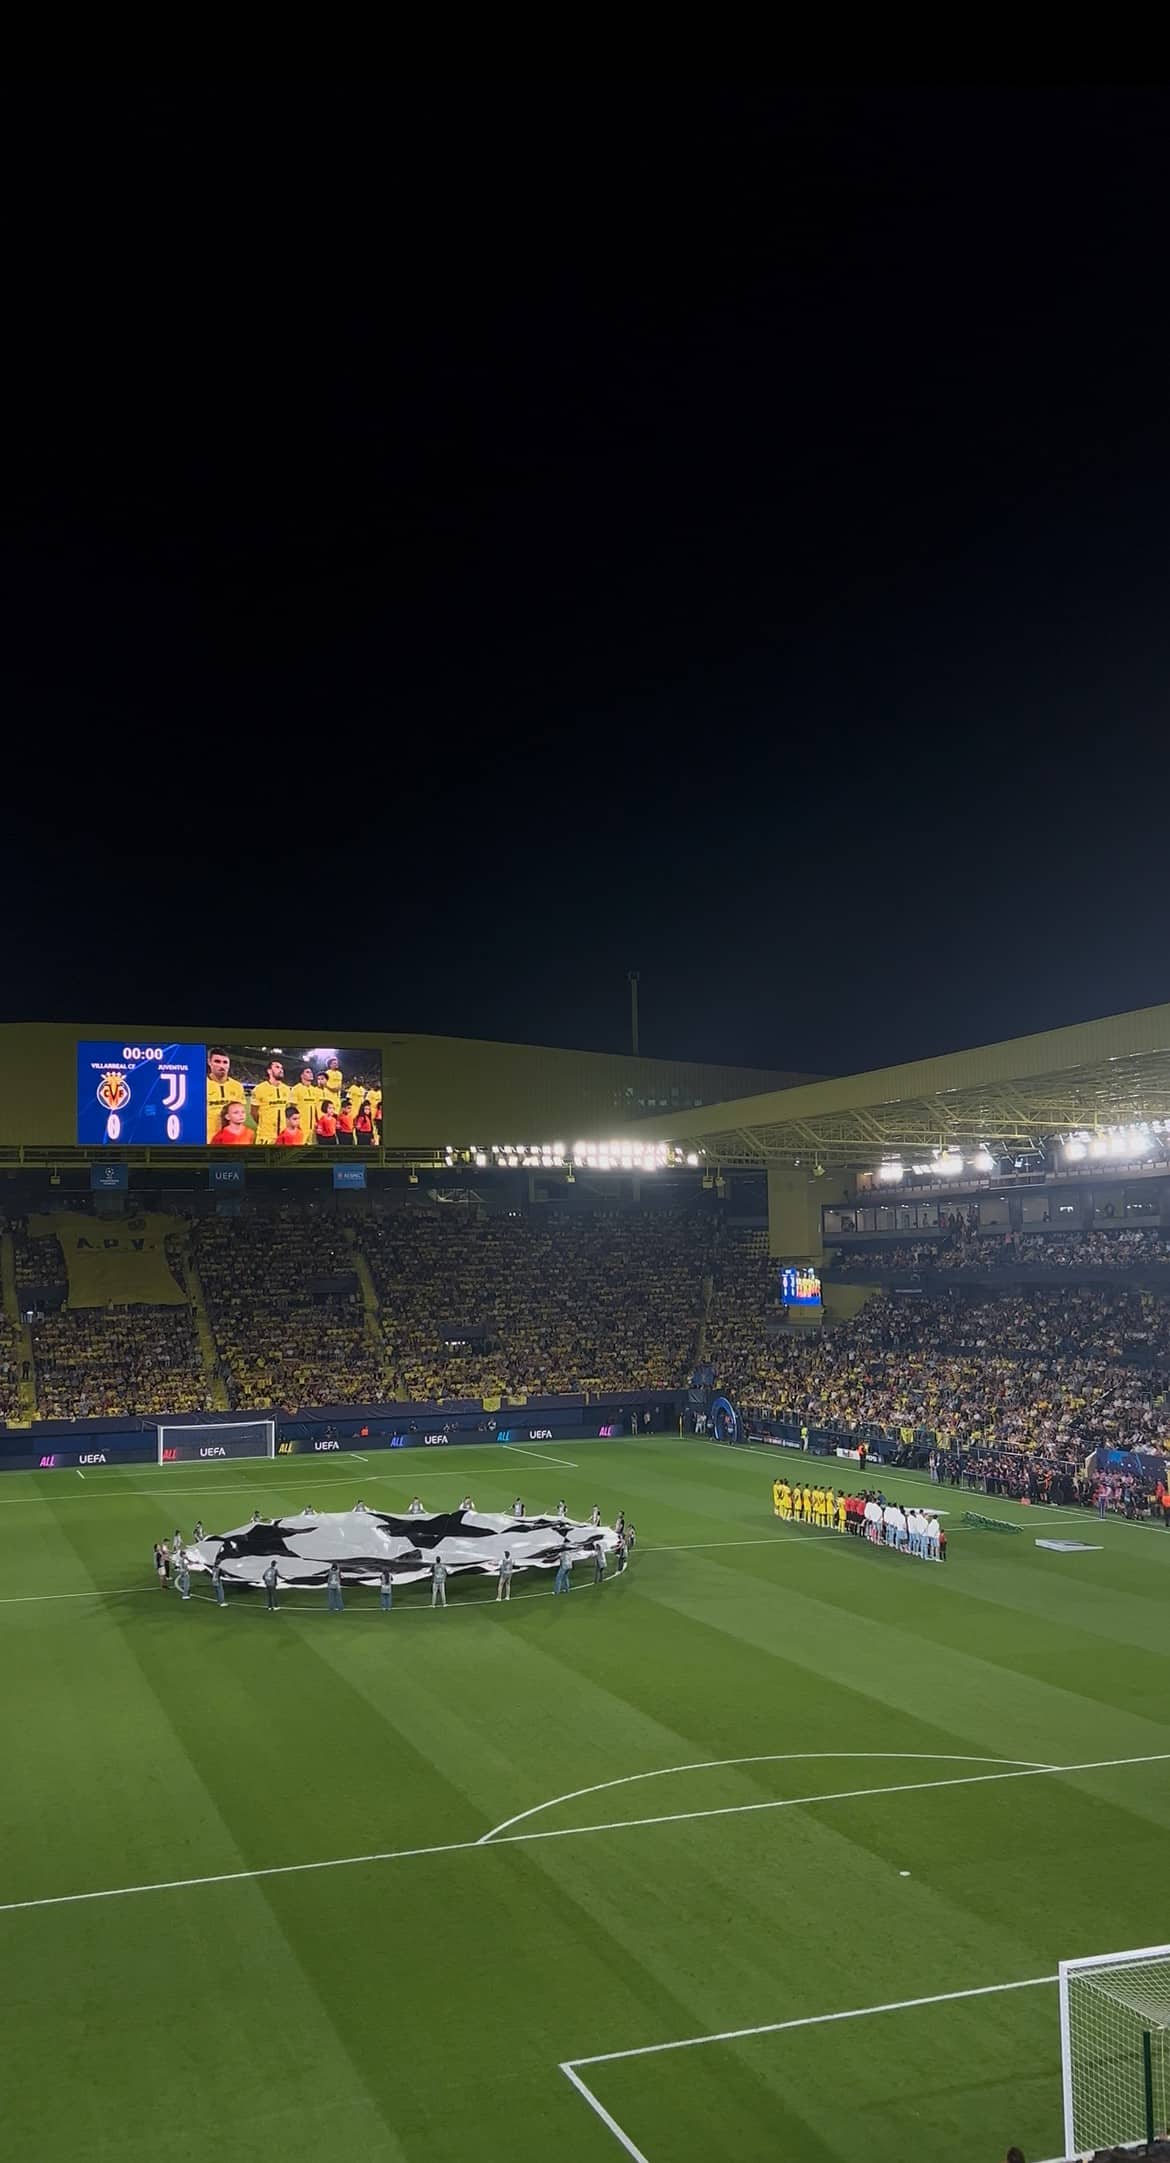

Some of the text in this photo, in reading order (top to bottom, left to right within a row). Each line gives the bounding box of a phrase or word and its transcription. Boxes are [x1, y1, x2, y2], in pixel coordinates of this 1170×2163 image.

[122, 1047, 163, 1060] 00:00
[107, 1113, 121, 1140] 0
[167, 1114, 180, 1140] 0
[215, 1171, 240, 1181] UEFA
[529, 1430, 553, 1439] UEFA
[424, 1435, 448, 1445] UEFA
[314, 1441, 340, 1450] UEFA
[200, 1447, 226, 1457] UEFA
[79, 1454, 106, 1464] UEFA
